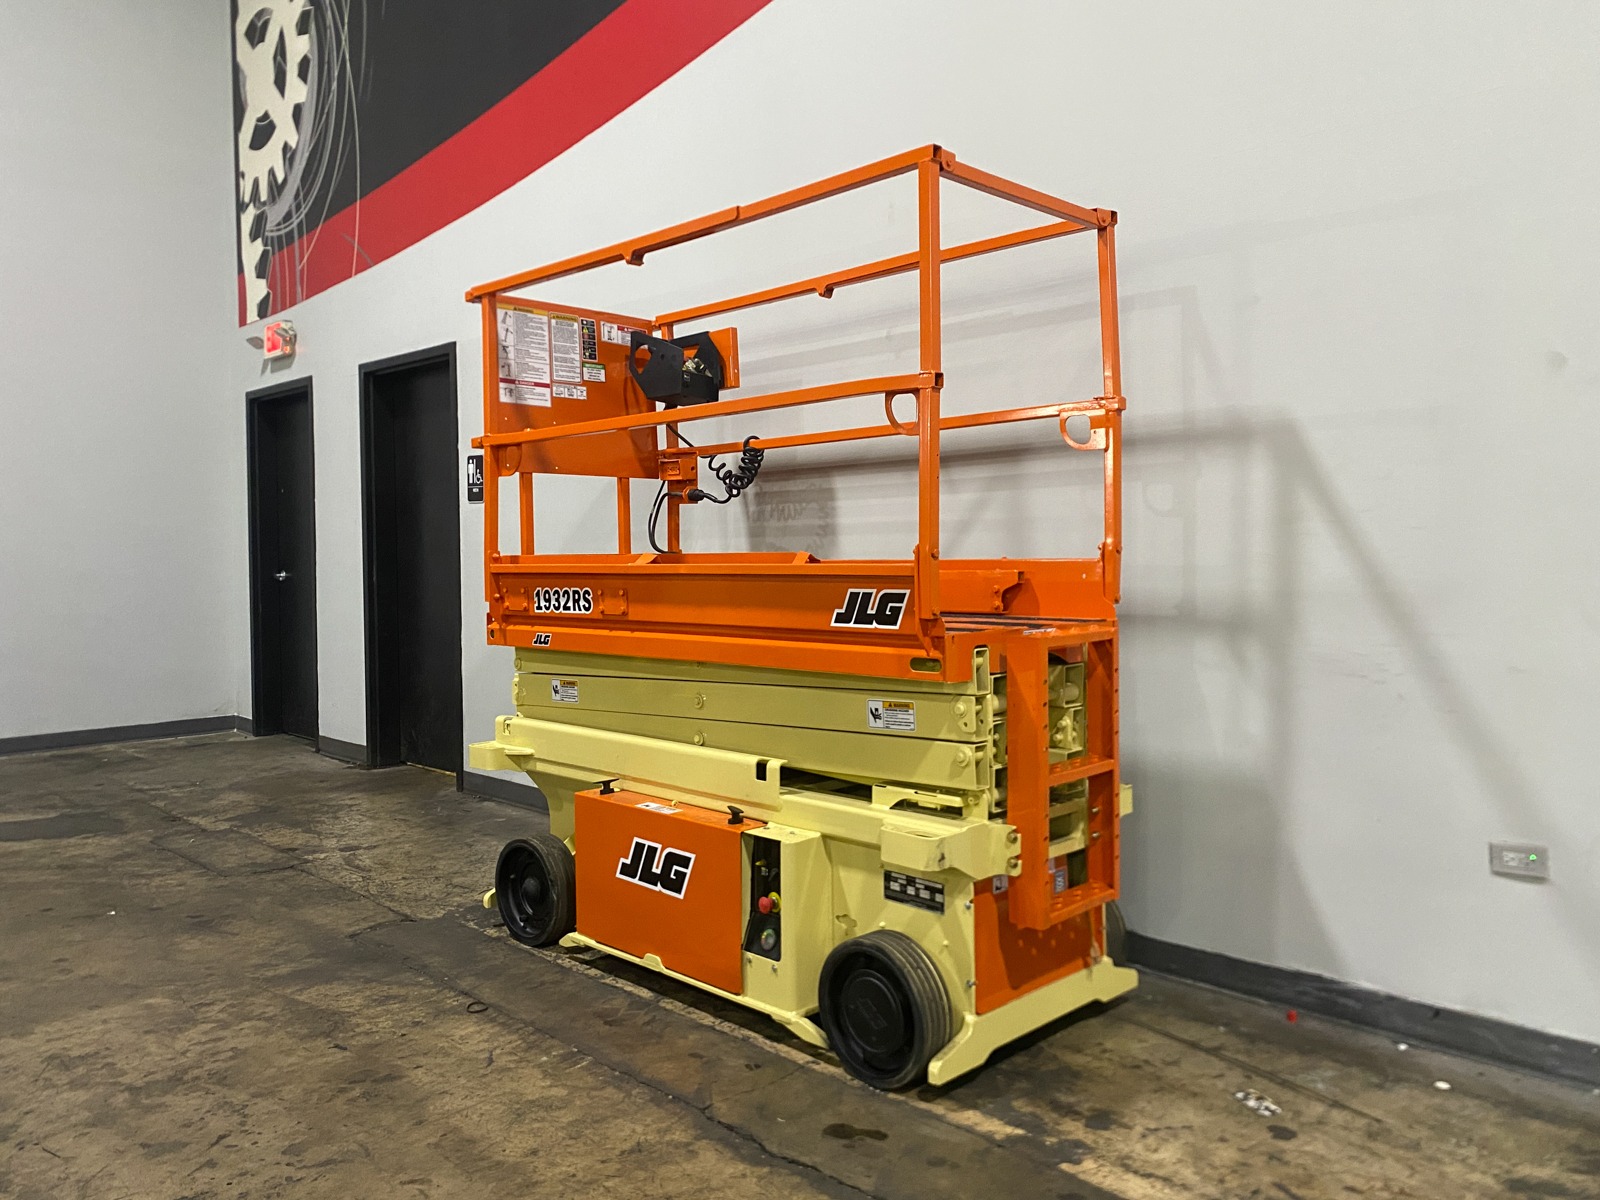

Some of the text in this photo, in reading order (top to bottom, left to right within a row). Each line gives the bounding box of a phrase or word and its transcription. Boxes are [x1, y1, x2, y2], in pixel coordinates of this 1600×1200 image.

[534, 588, 592, 613] 1932RS
[832, 590, 909, 628] JLG
[533, 633, 551, 646] JLG
[617, 838, 694, 898] JLG
